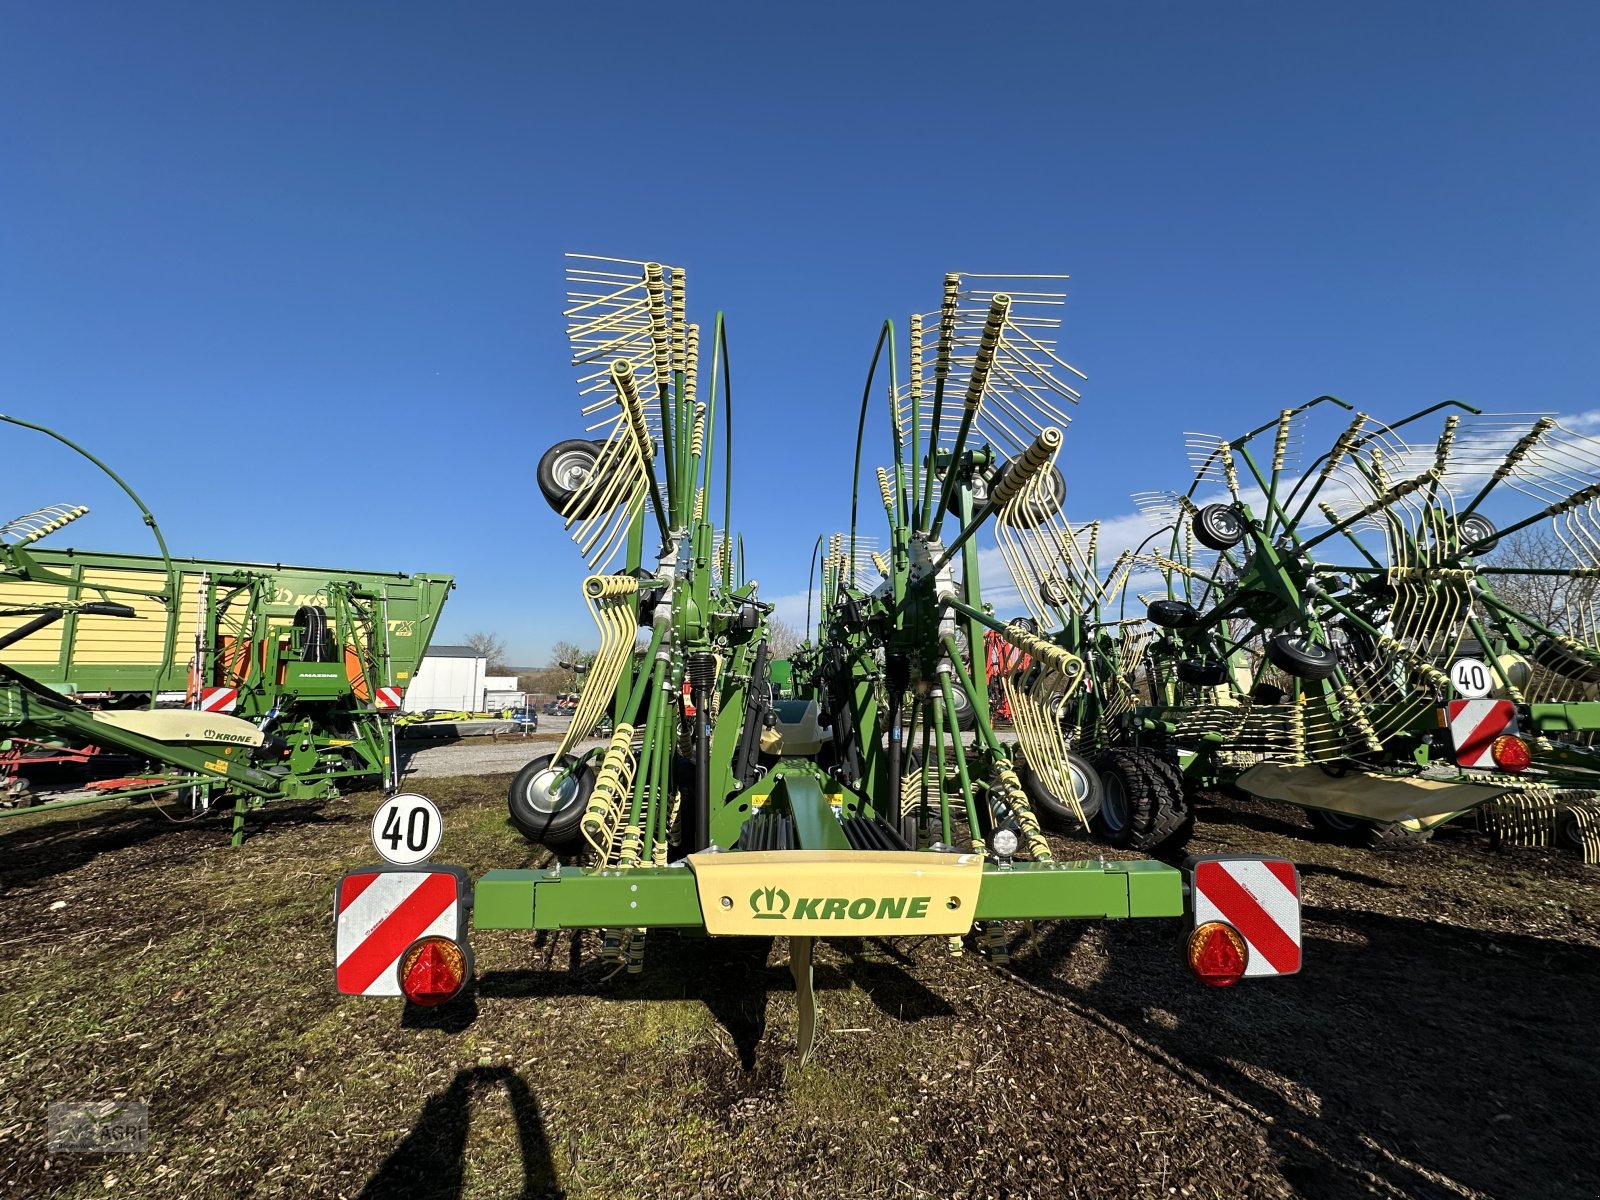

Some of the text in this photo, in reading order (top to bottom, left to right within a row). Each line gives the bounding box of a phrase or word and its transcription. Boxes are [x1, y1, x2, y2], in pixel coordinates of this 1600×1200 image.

[387, 620, 416, 632] TX
[1459, 665, 1485, 690] 40
[215, 732, 252, 743] KRONE
[381, 806, 430, 852] 40
[792, 896, 931, 920] KRONE
